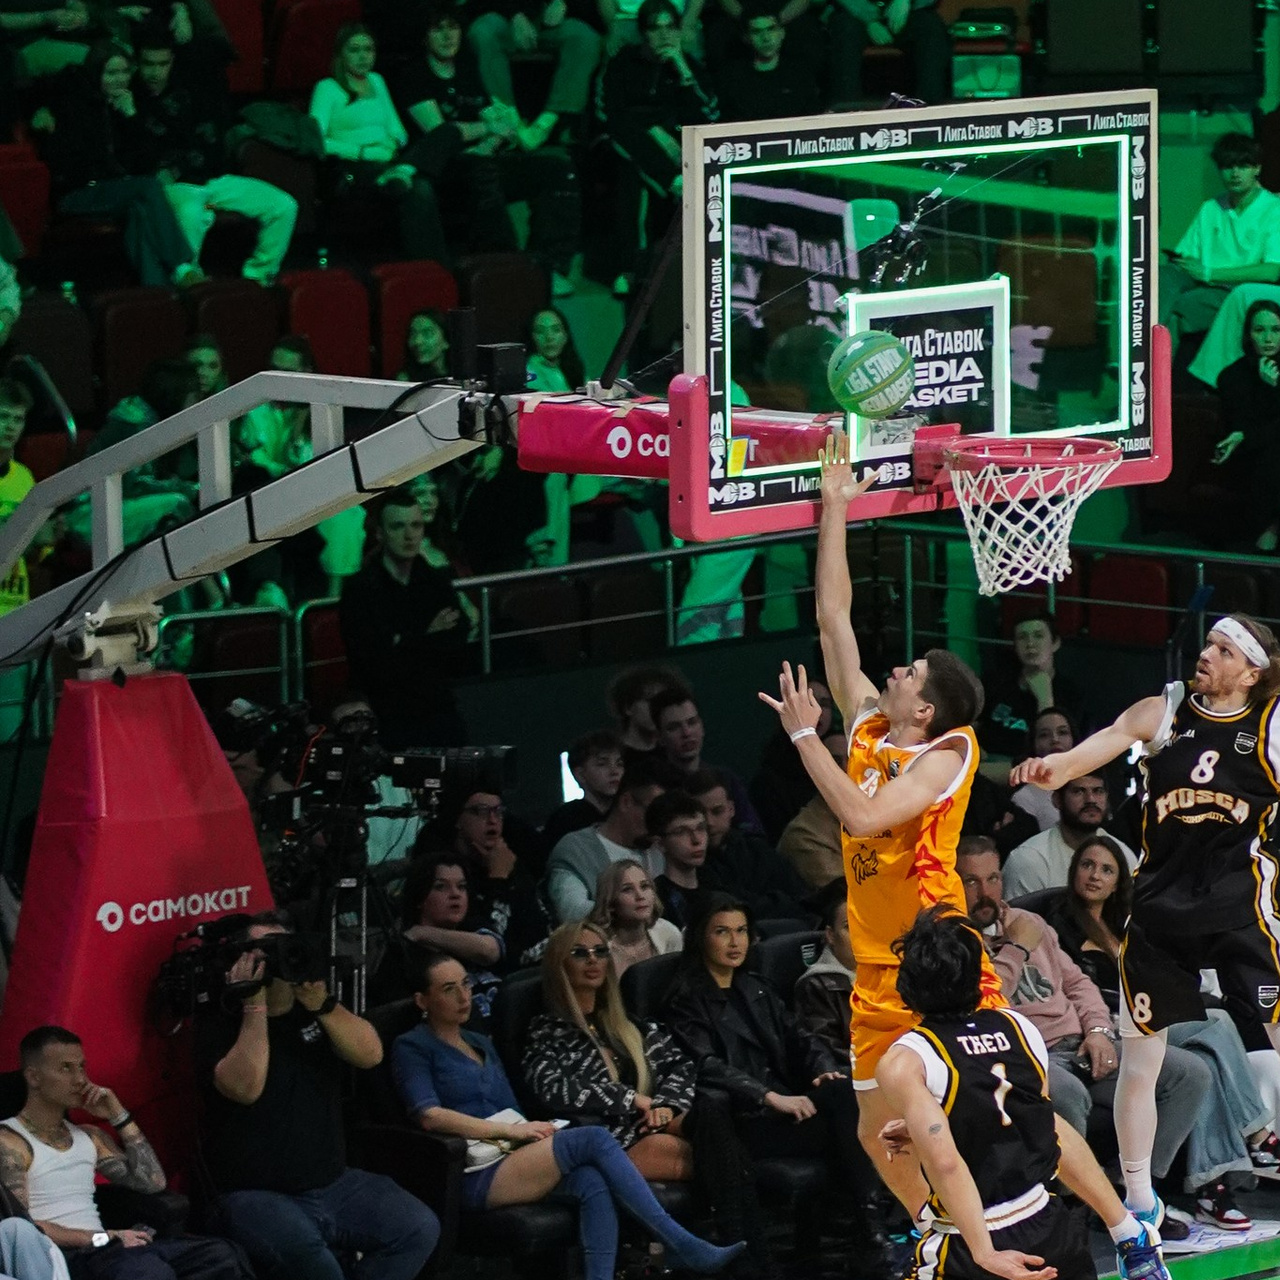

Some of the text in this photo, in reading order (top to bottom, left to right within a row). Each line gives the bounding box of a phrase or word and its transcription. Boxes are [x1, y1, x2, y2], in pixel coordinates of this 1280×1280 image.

[924, 328, 984, 357] СТАВОК
[913, 357, 984, 387] EDIA
[902, 383, 985, 409] ASKET
[1190, 749, 1220, 784] 8
[1155, 787, 1250, 825] MOSCA
[1132, 992, 1153, 1023] 8
[956, 1031, 1012, 1056] THEO
